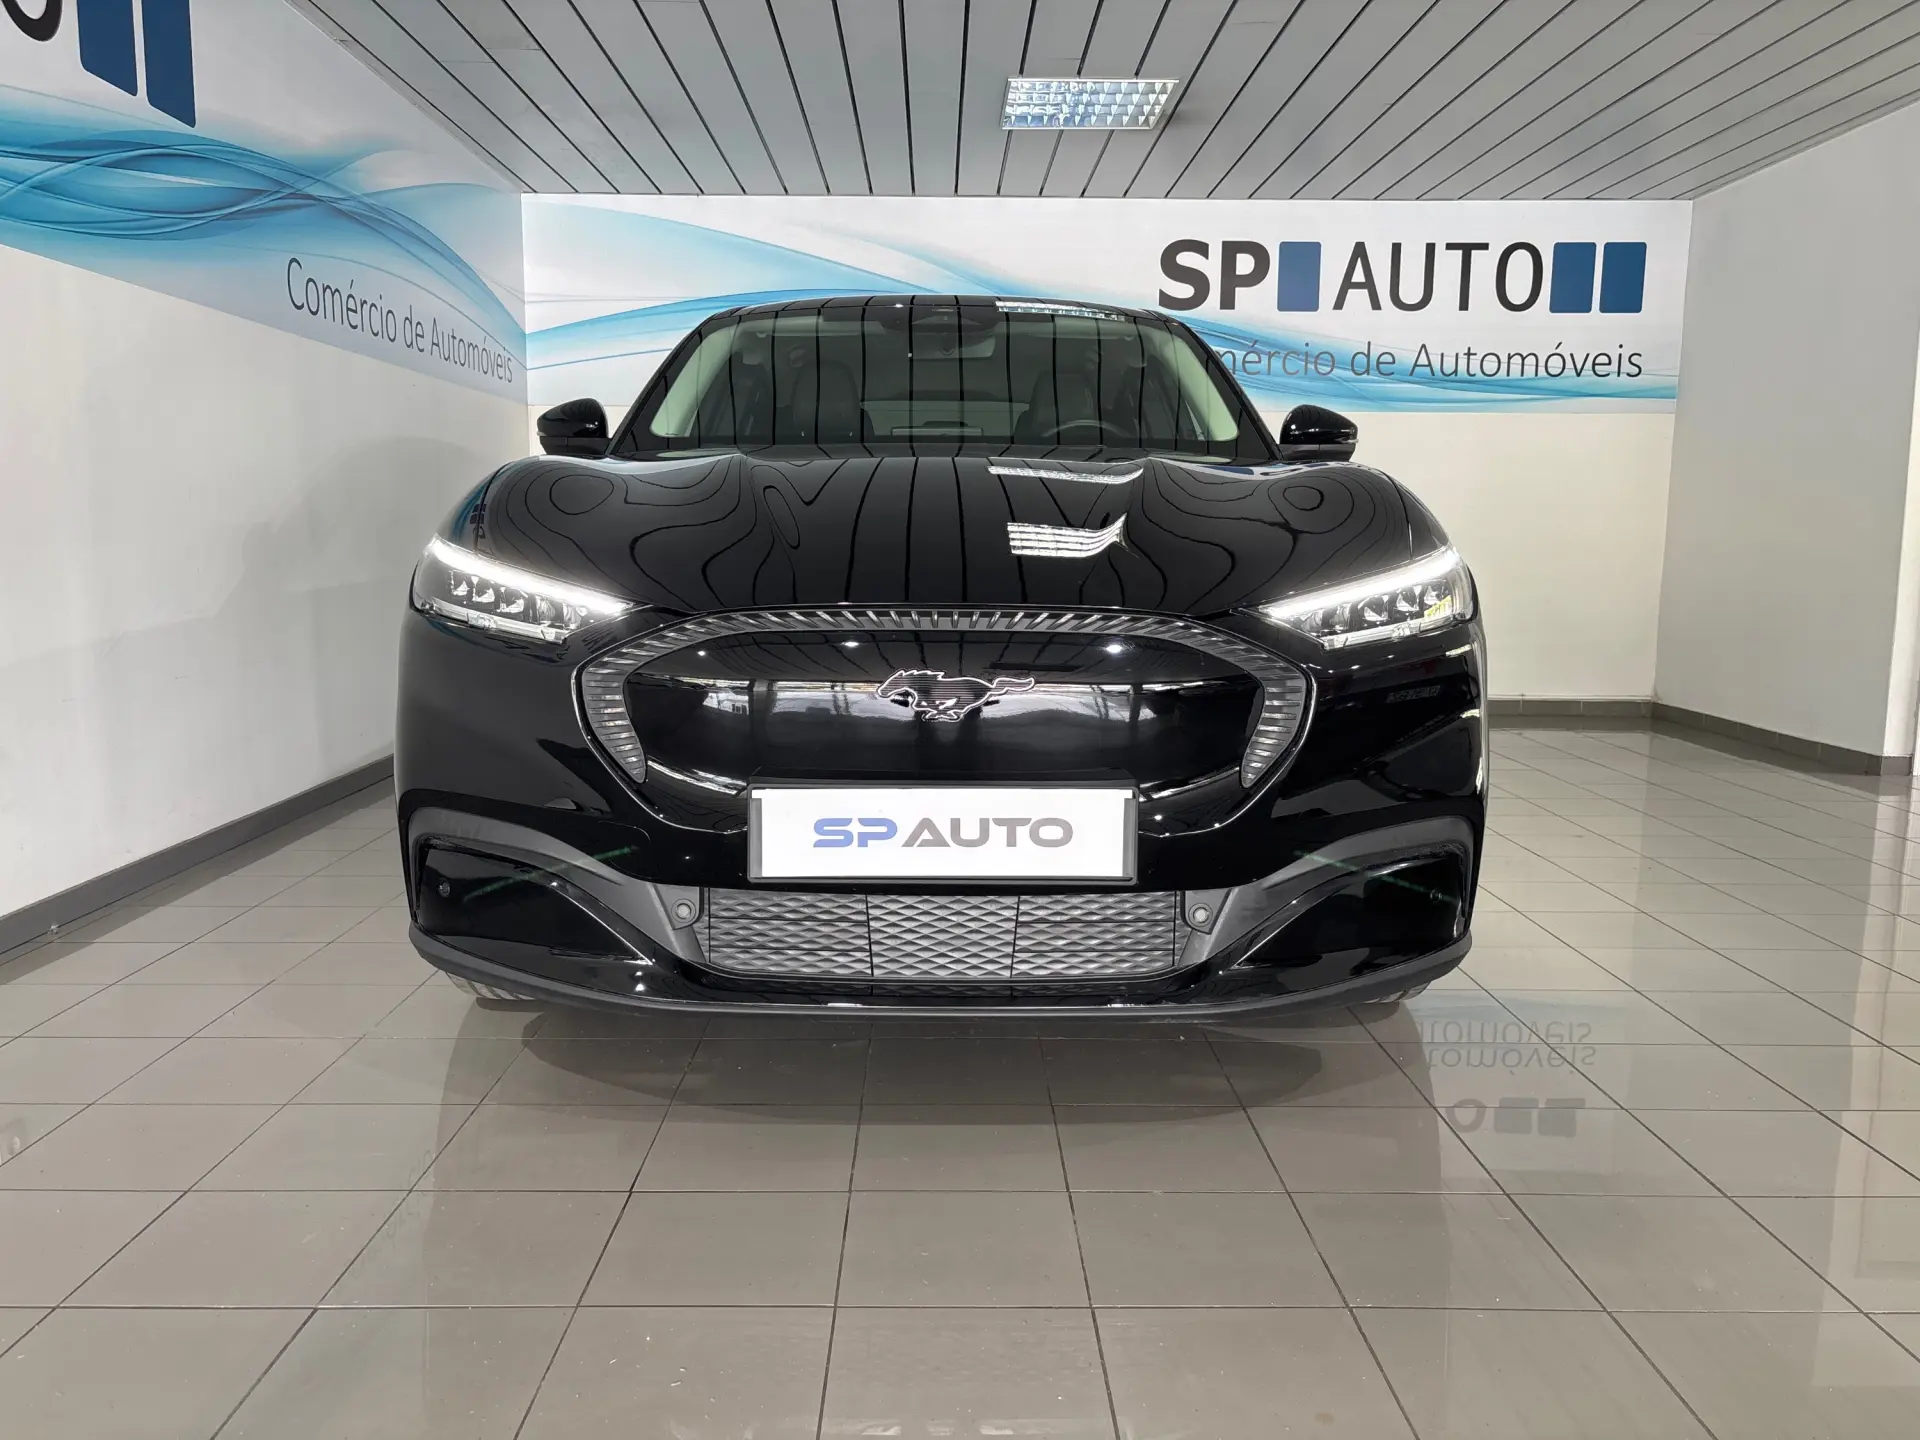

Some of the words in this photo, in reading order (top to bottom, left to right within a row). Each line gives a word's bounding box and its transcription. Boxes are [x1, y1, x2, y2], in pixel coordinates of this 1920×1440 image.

[1158, 239, 1271, 312] SP
[1332, 241, 1545, 313] AUTO
[287, 257, 397, 343] Comércio
[403, 304, 425, 353] de
[430, 317, 513, 384] Automóveis
[1213, 339, 1336, 377] mércio
[1350, 341, 1396, 377] de
[1408, 341, 1643, 378] Automóveis
[813, 817, 898, 848] SP
[901, 817, 1074, 848] AUTO
